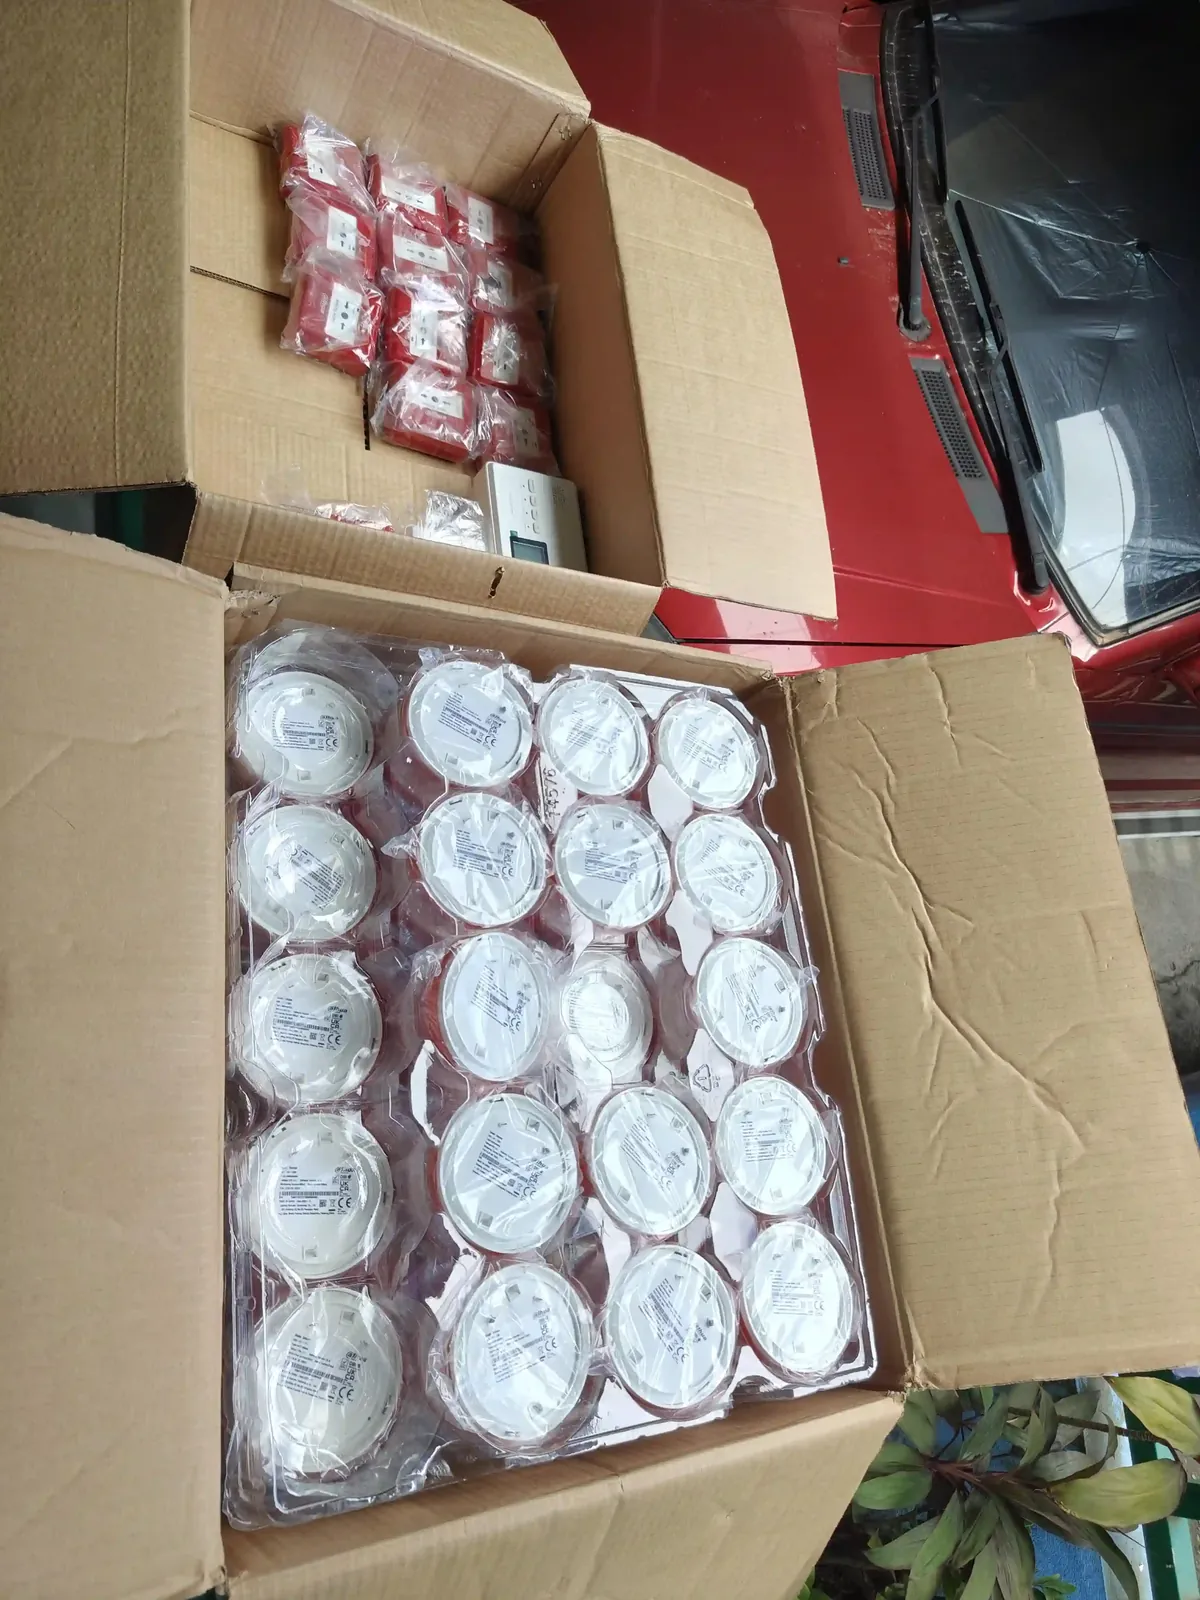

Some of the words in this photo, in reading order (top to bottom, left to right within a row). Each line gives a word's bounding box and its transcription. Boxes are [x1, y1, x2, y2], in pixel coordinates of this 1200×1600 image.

[326, 738, 338, 747] CE
[484, 735, 497, 747] CE
[501, 866, 514, 877] CE
[511, 1017, 521, 1031] CE
[327, 1034, 341, 1045] CE
[338, 1197, 352, 1208] CE
[545, 1337, 557, 1351] CE
[339, 1386, 354, 1402] CE
